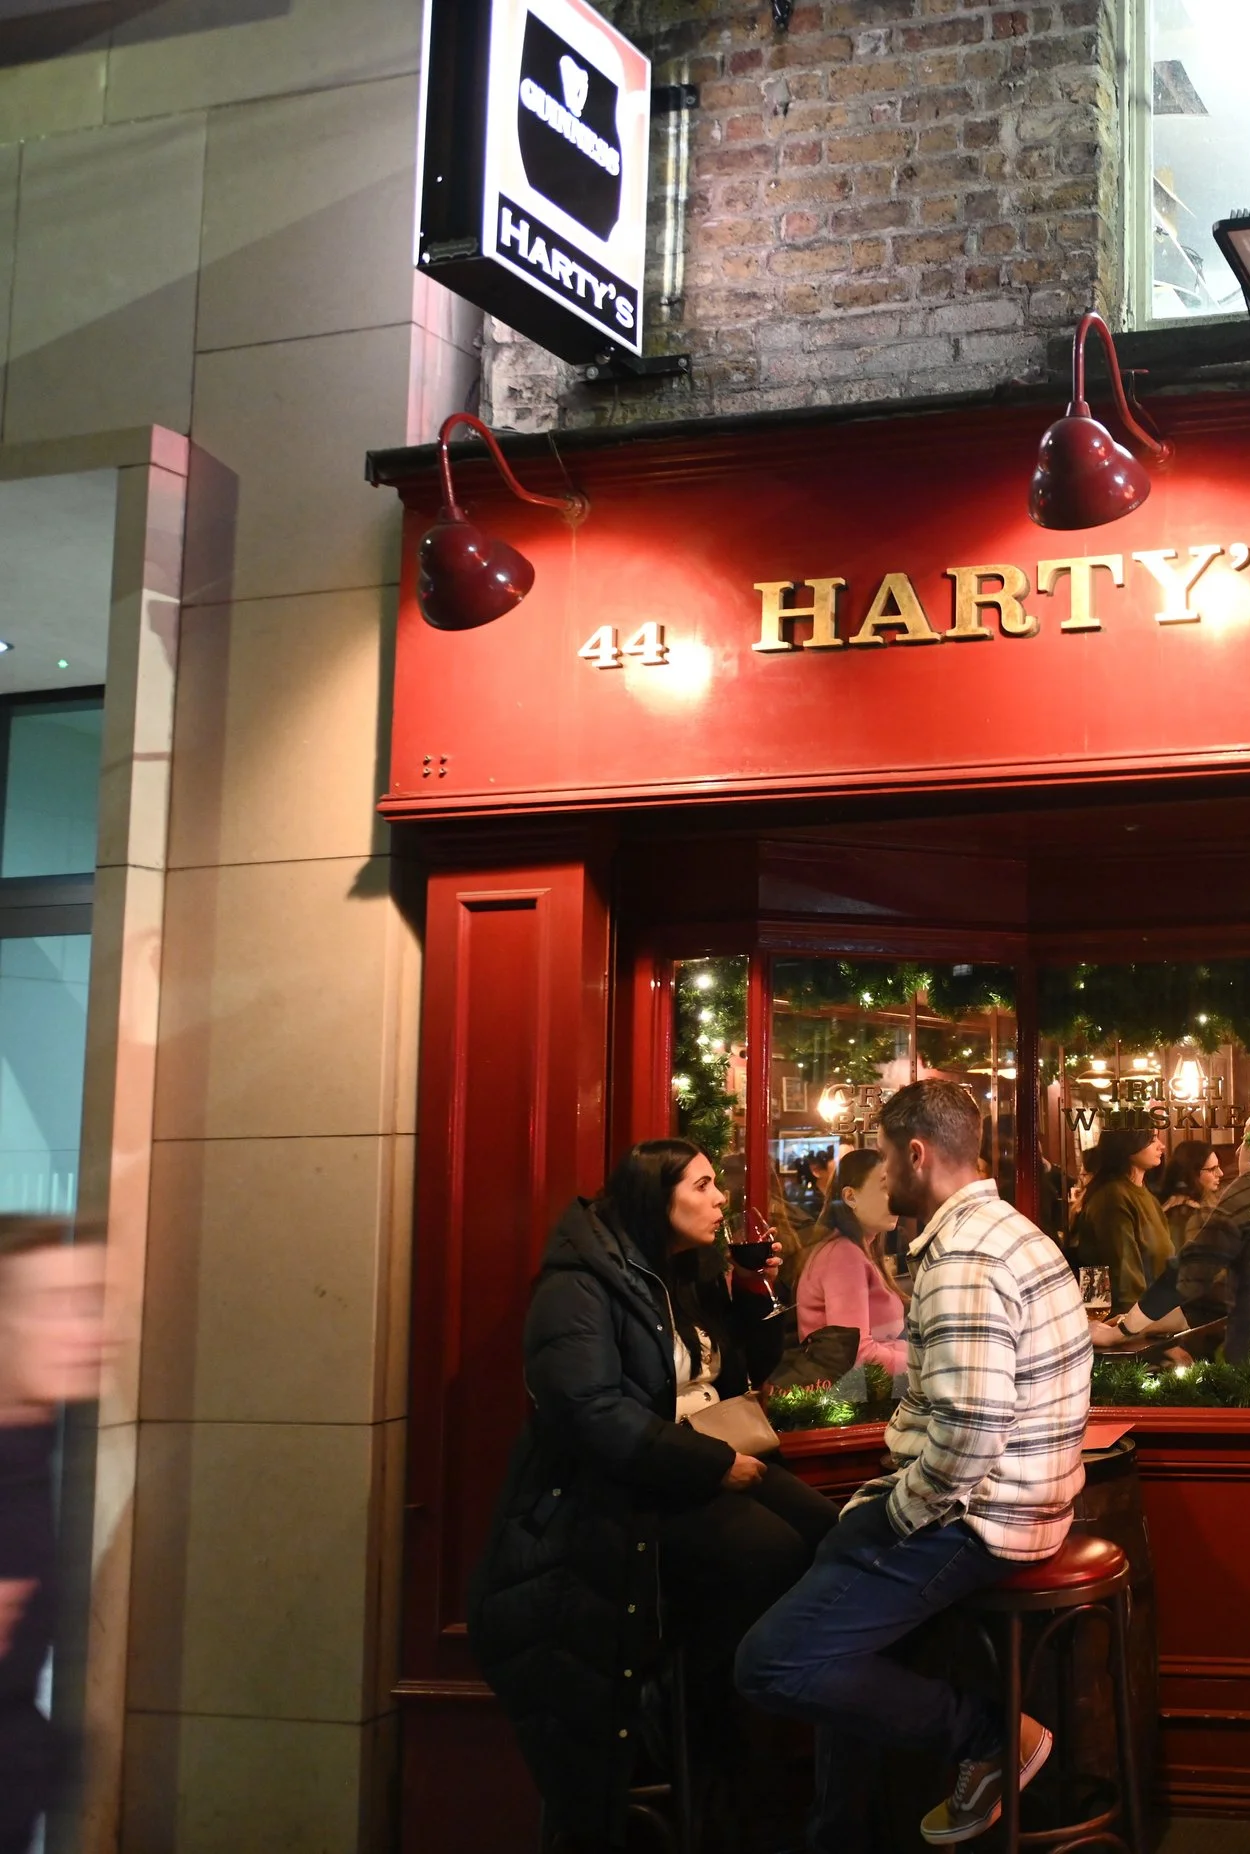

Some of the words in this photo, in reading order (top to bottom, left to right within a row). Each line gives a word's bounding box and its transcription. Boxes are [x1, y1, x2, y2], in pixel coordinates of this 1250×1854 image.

[501, 206, 635, 330] HARTY'S
[577, 621, 667, 670] 44
[1109, 1076, 1224, 1102] IRISH
